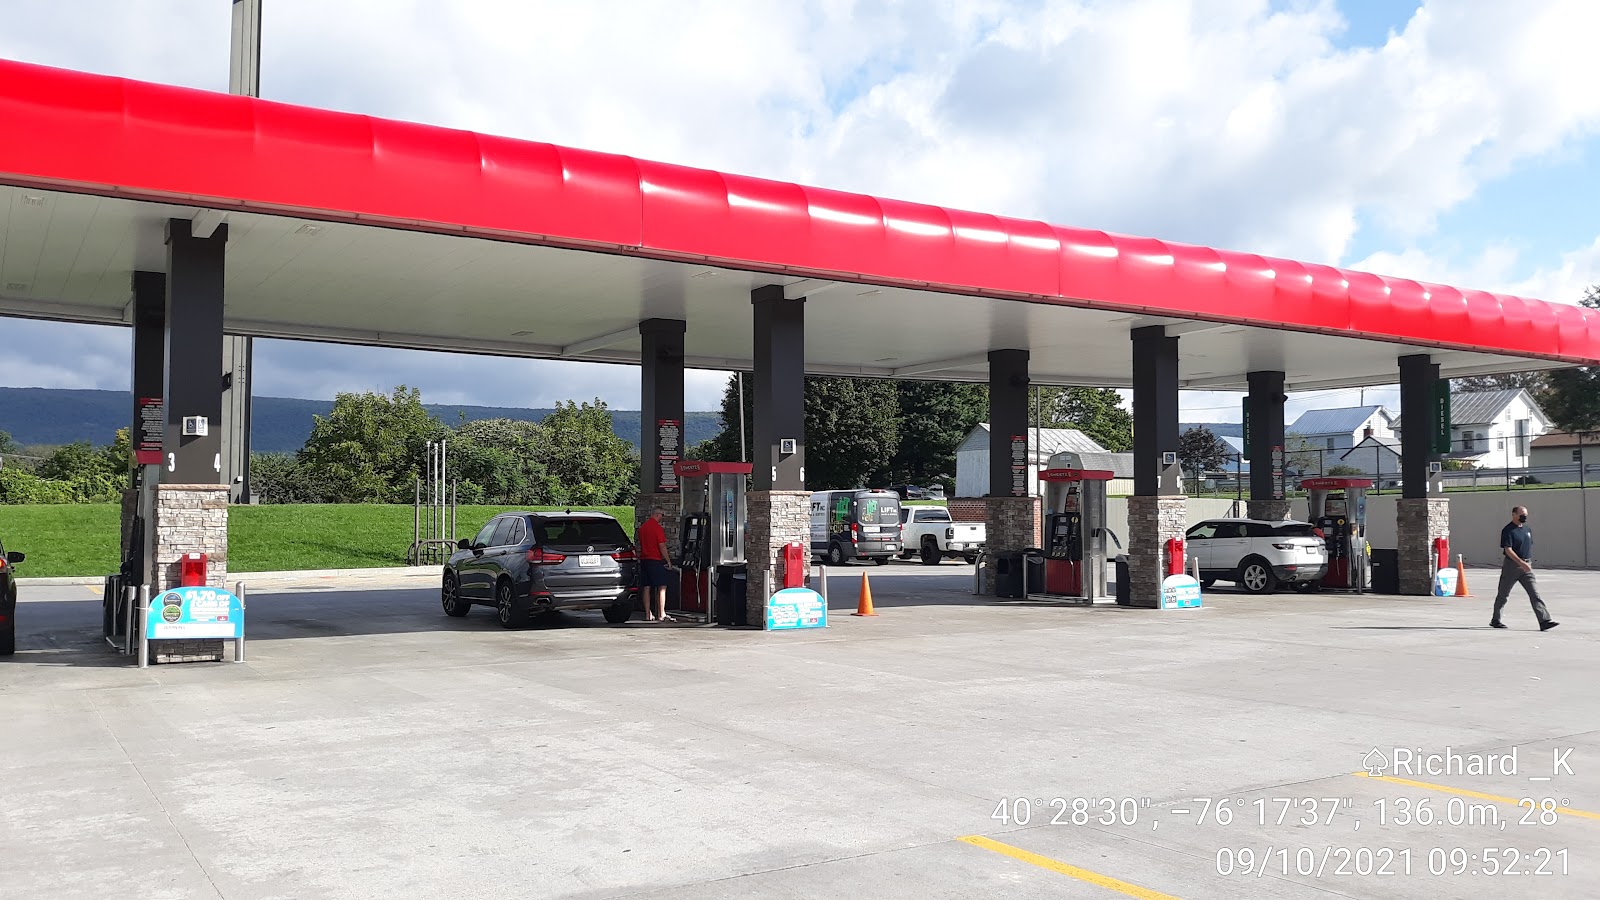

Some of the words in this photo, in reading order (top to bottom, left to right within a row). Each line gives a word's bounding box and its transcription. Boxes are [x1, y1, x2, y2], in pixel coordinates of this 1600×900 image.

[168, 452, 175, 472] 3
[214, 453, 221, 473] 4
[772, 466, 777, 482] 5
[800, 466, 805, 482] 6
[1157, 475, 1161, 489] 7
